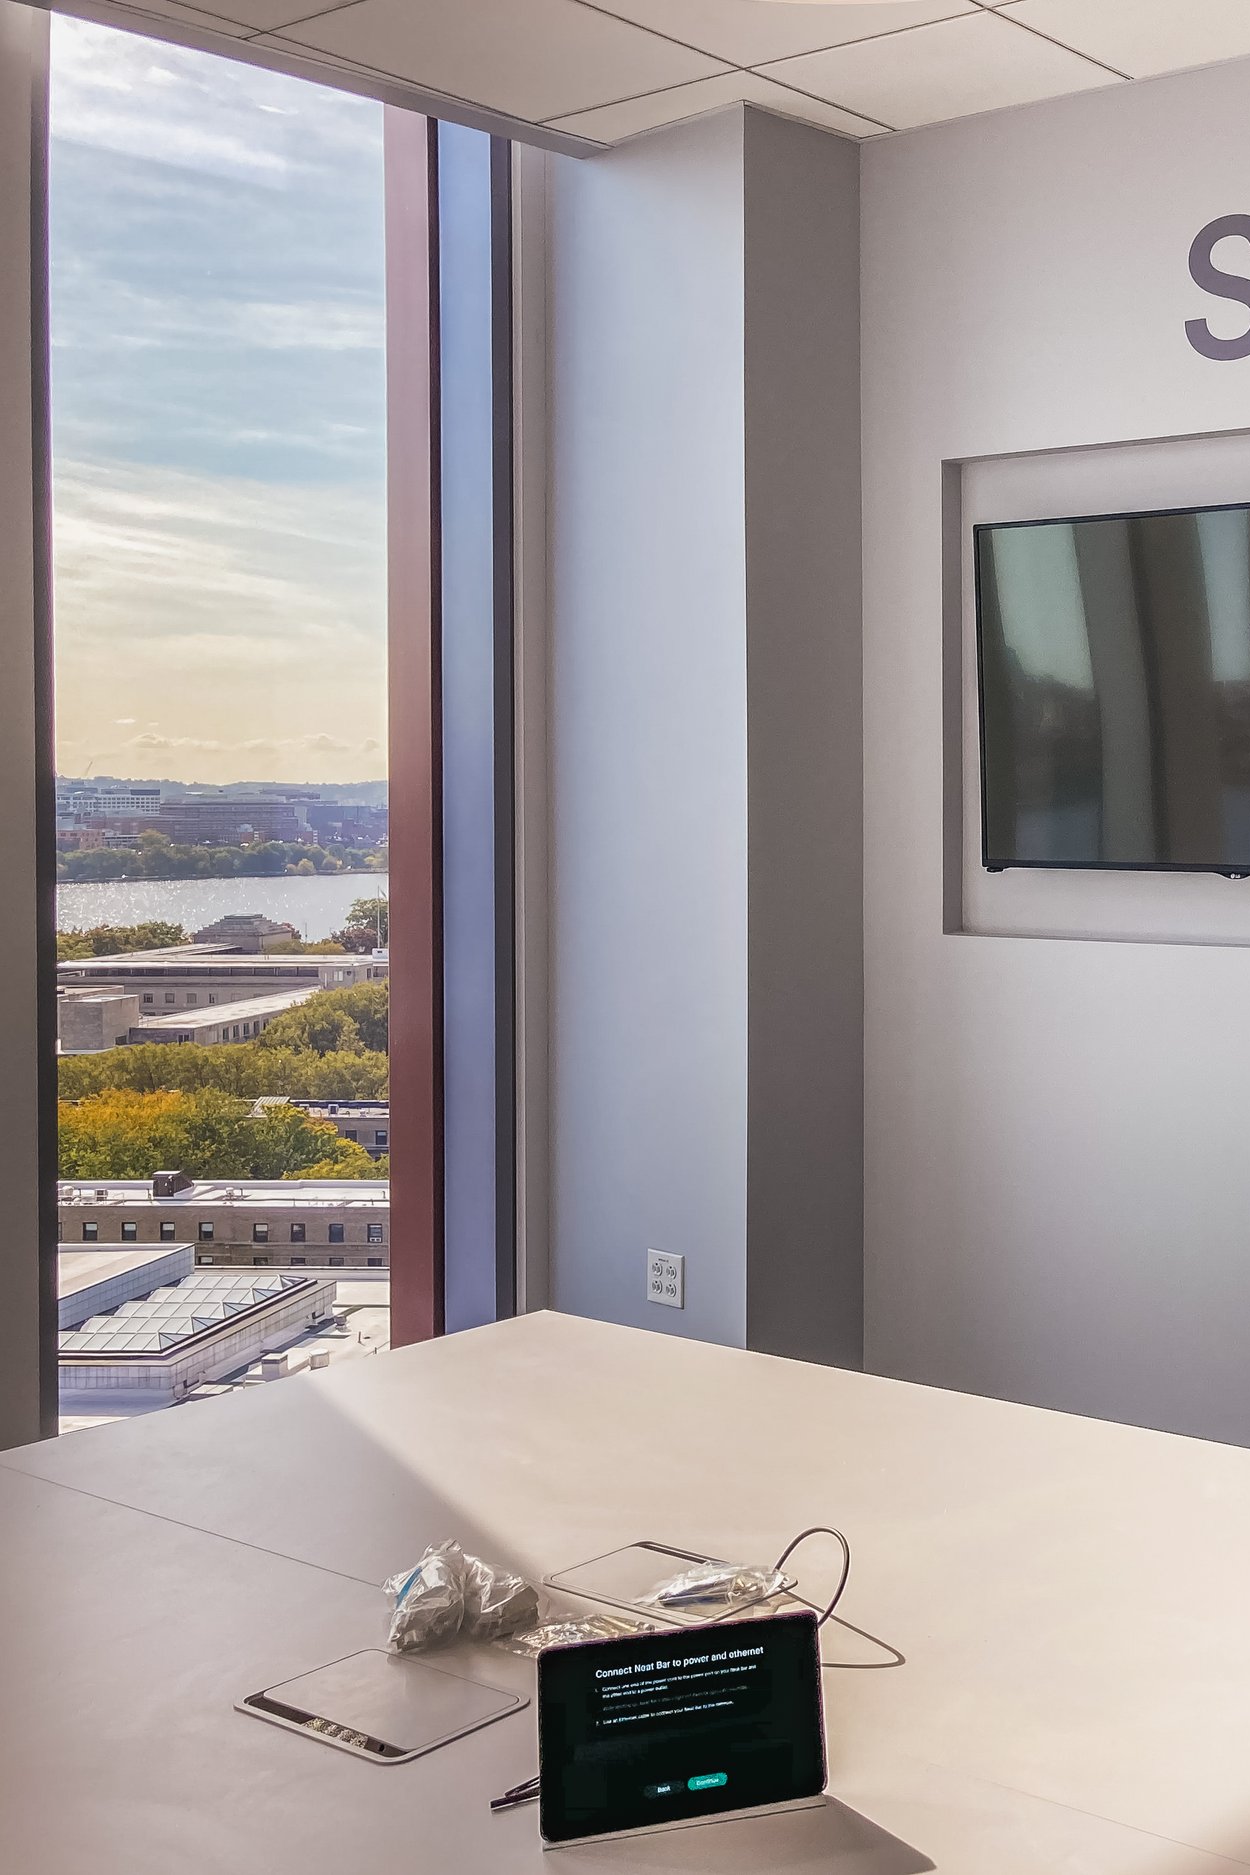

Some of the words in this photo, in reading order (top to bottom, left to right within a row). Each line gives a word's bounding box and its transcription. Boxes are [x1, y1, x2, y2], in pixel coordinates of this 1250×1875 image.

[595, 1666, 633, 1679] Connect
[634, 1663, 655, 1673] Neat
[656, 1660, 671, 1670] Bar
[672, 1659, 681, 1667] to
[683, 1655, 710, 1667] power
[711, 1651, 727, 1662] and
[728, 1646, 764, 1659] ethernet
